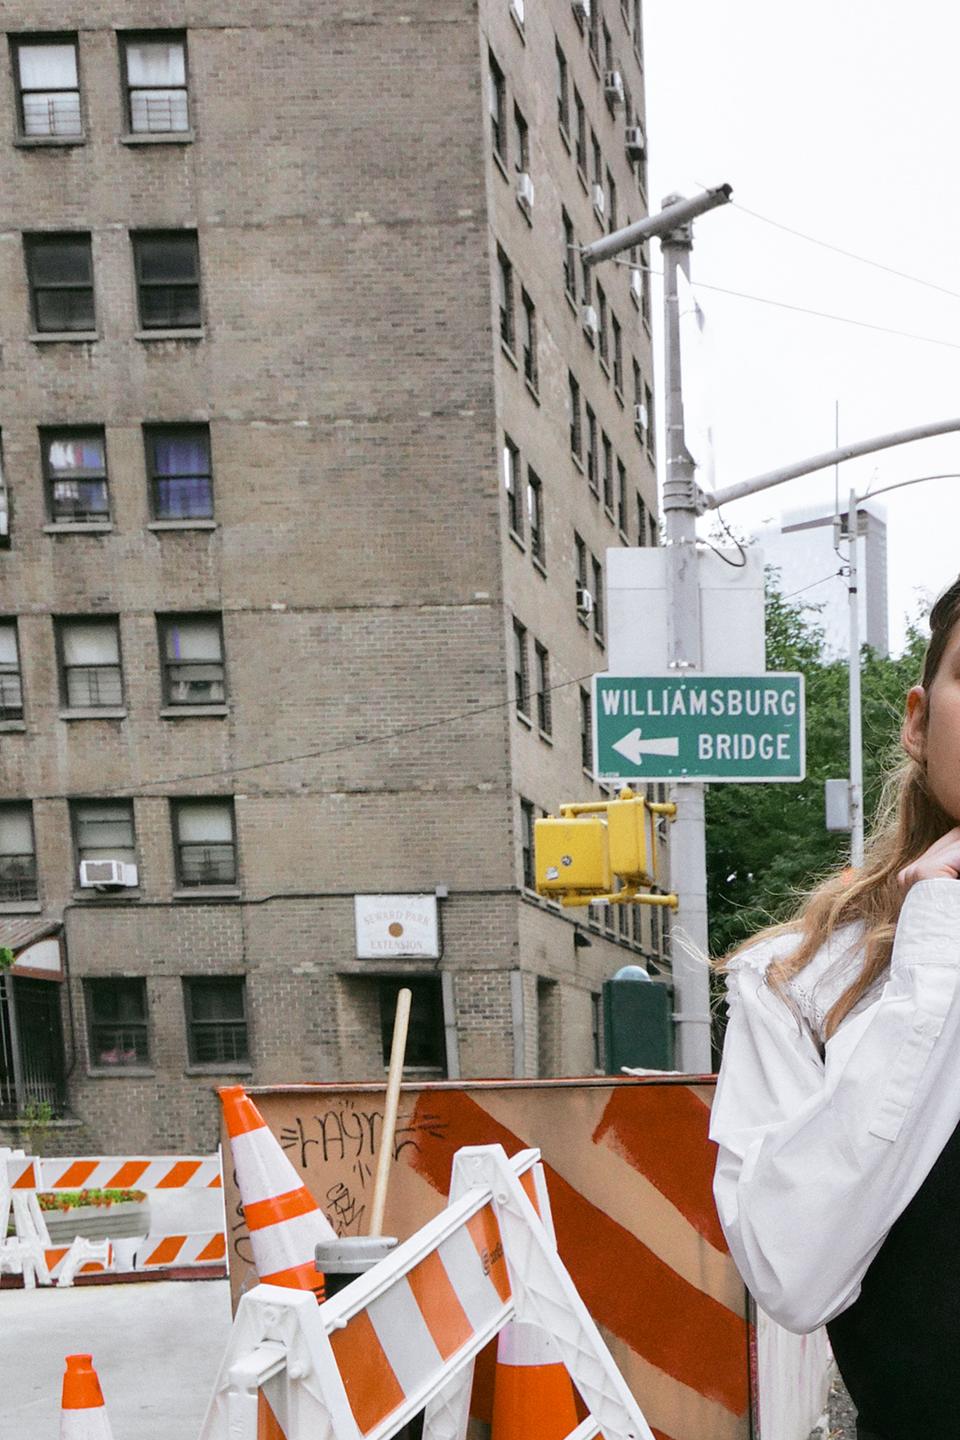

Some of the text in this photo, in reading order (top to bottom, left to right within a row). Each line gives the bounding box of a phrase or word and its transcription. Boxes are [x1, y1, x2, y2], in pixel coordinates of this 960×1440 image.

[601, 689, 796, 716] WILLIAMSBURG
[698, 733, 791, 760] BRIDGE
[405, 910, 431, 927] PARK
[370, 939, 423, 950] EXTENSION
